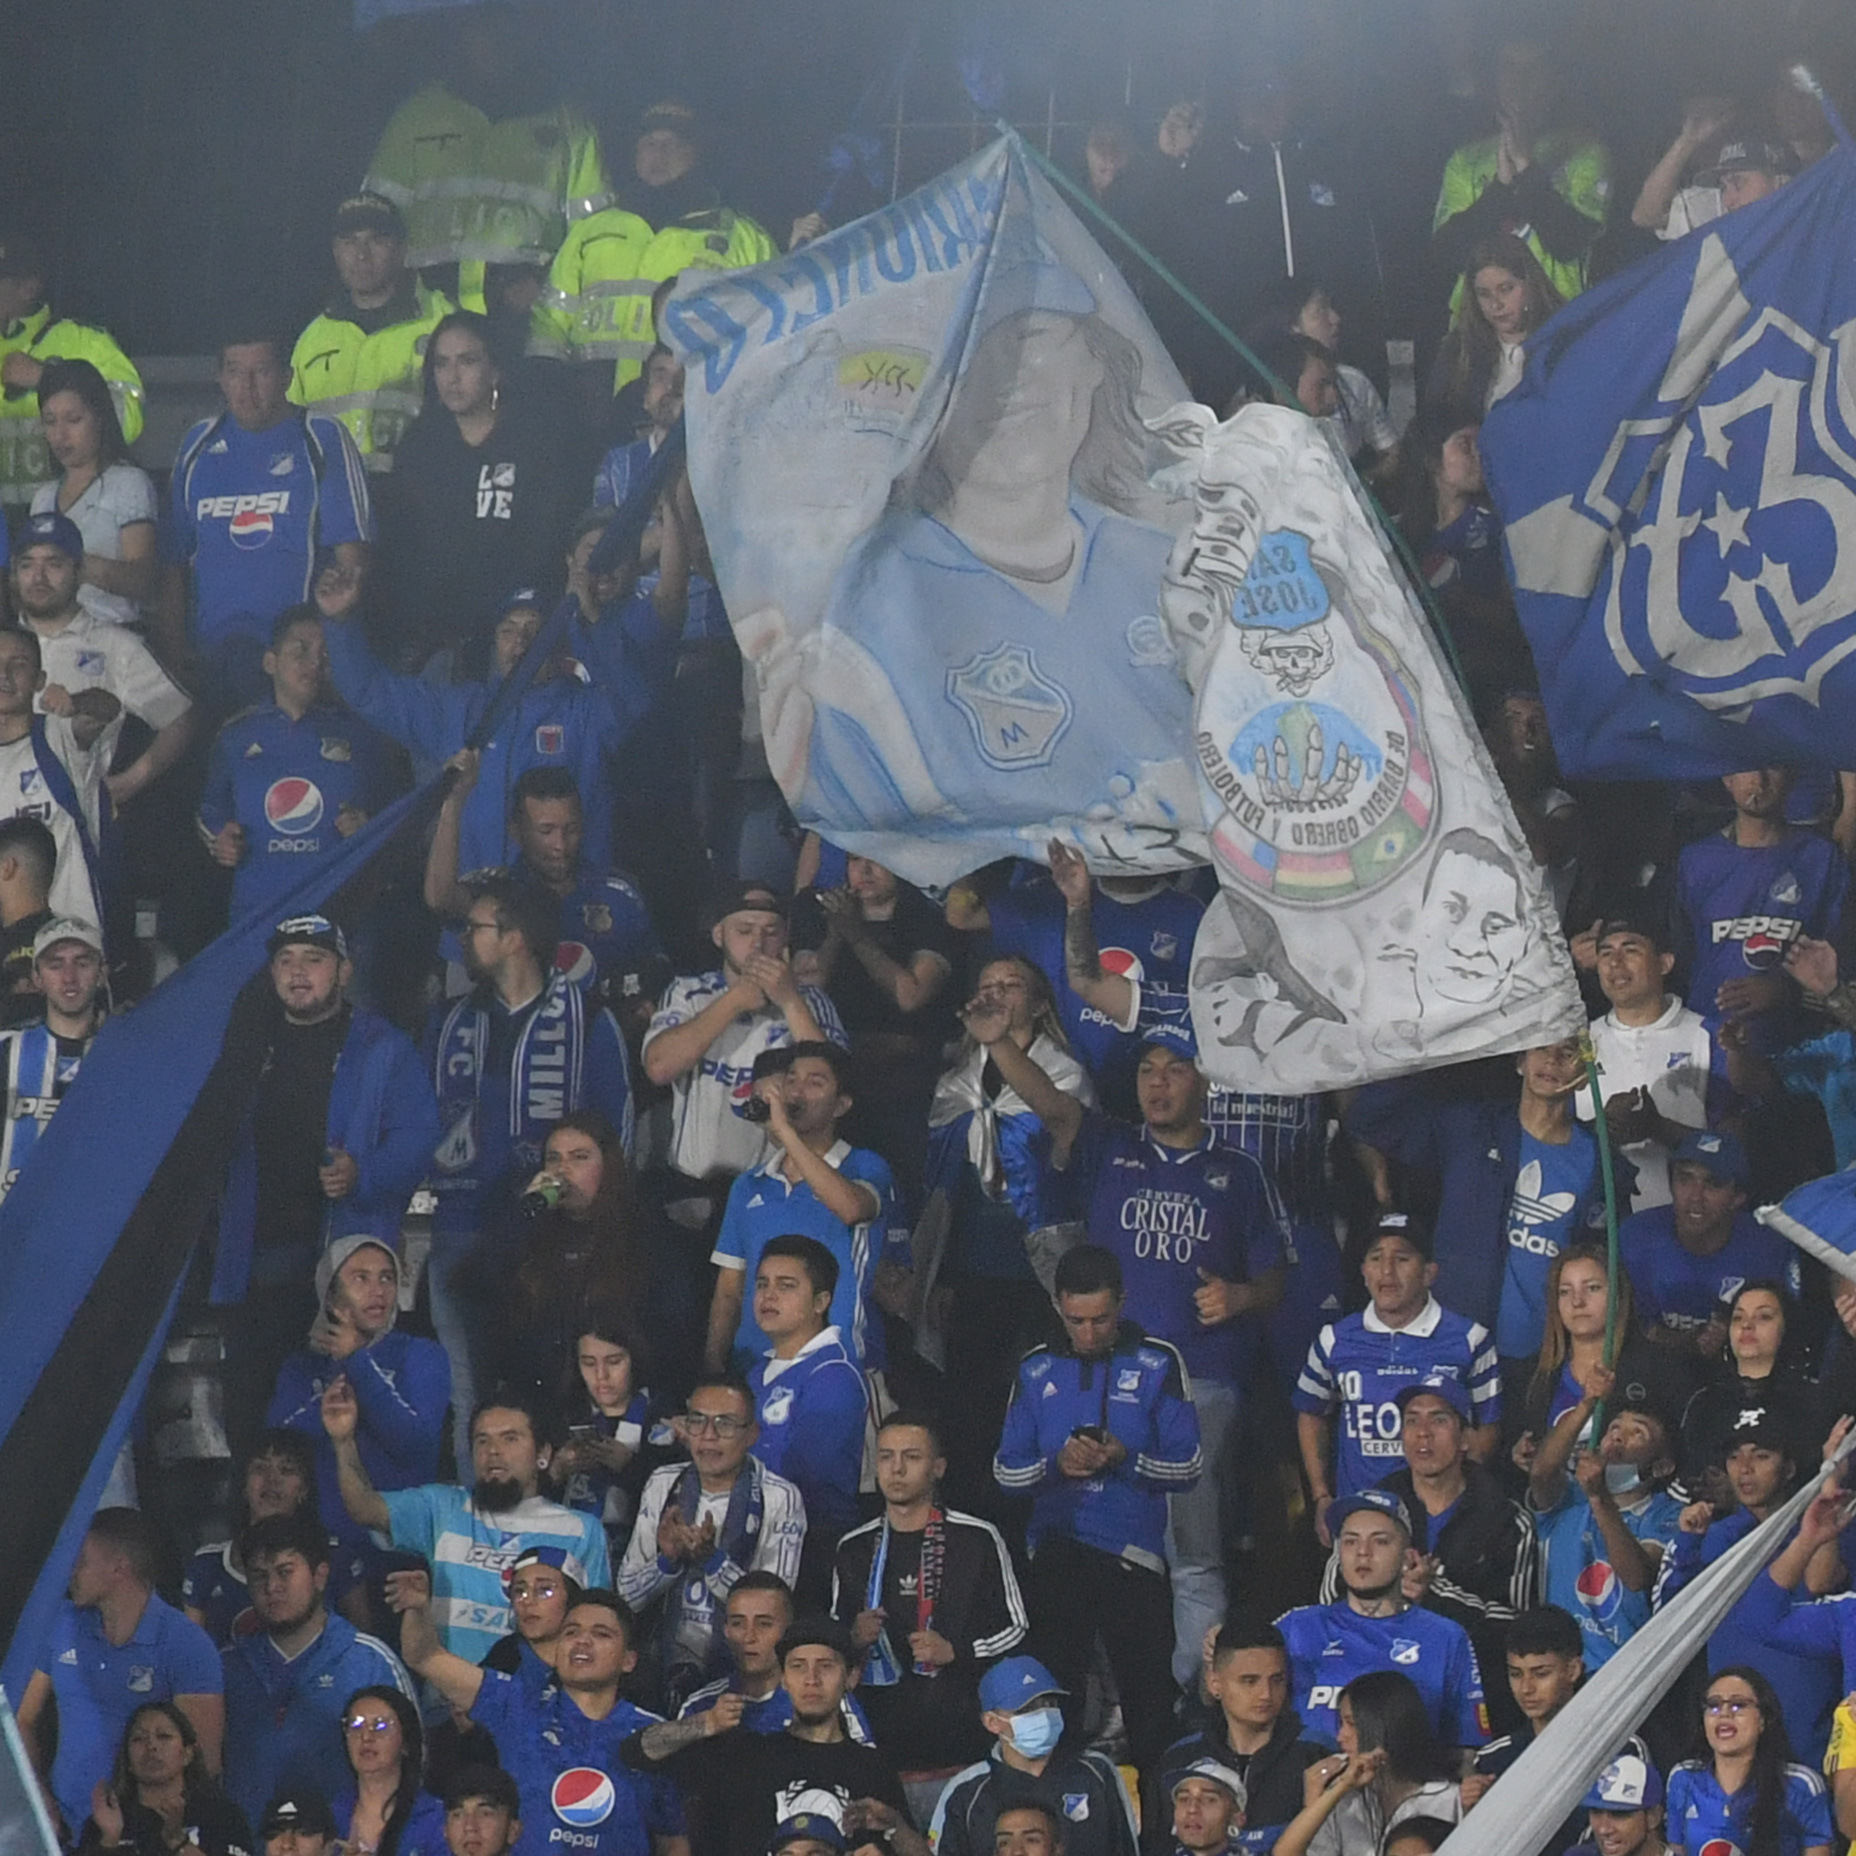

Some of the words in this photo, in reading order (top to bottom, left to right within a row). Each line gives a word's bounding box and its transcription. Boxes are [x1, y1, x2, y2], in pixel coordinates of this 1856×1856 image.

[197, 491, 290, 518] PEPSI
[268, 836, 321, 853] pepsi
[1711, 915, 1802, 944] PEPSI
[1079, 1005, 1113, 1025] pep
[700, 1058, 754, 1086] PEP
[15, 1097, 59, 1120] PE
[1136, 1188, 1201, 1207] CERVEZA
[1120, 1197, 1212, 1242] CRISTAL
[1134, 1229, 1194, 1264] ORO
[1344, 1401, 1402, 1439] LEO
[1362, 1439, 1406, 1457] CERV
[549, 1827, 601, 1849] pepsi
